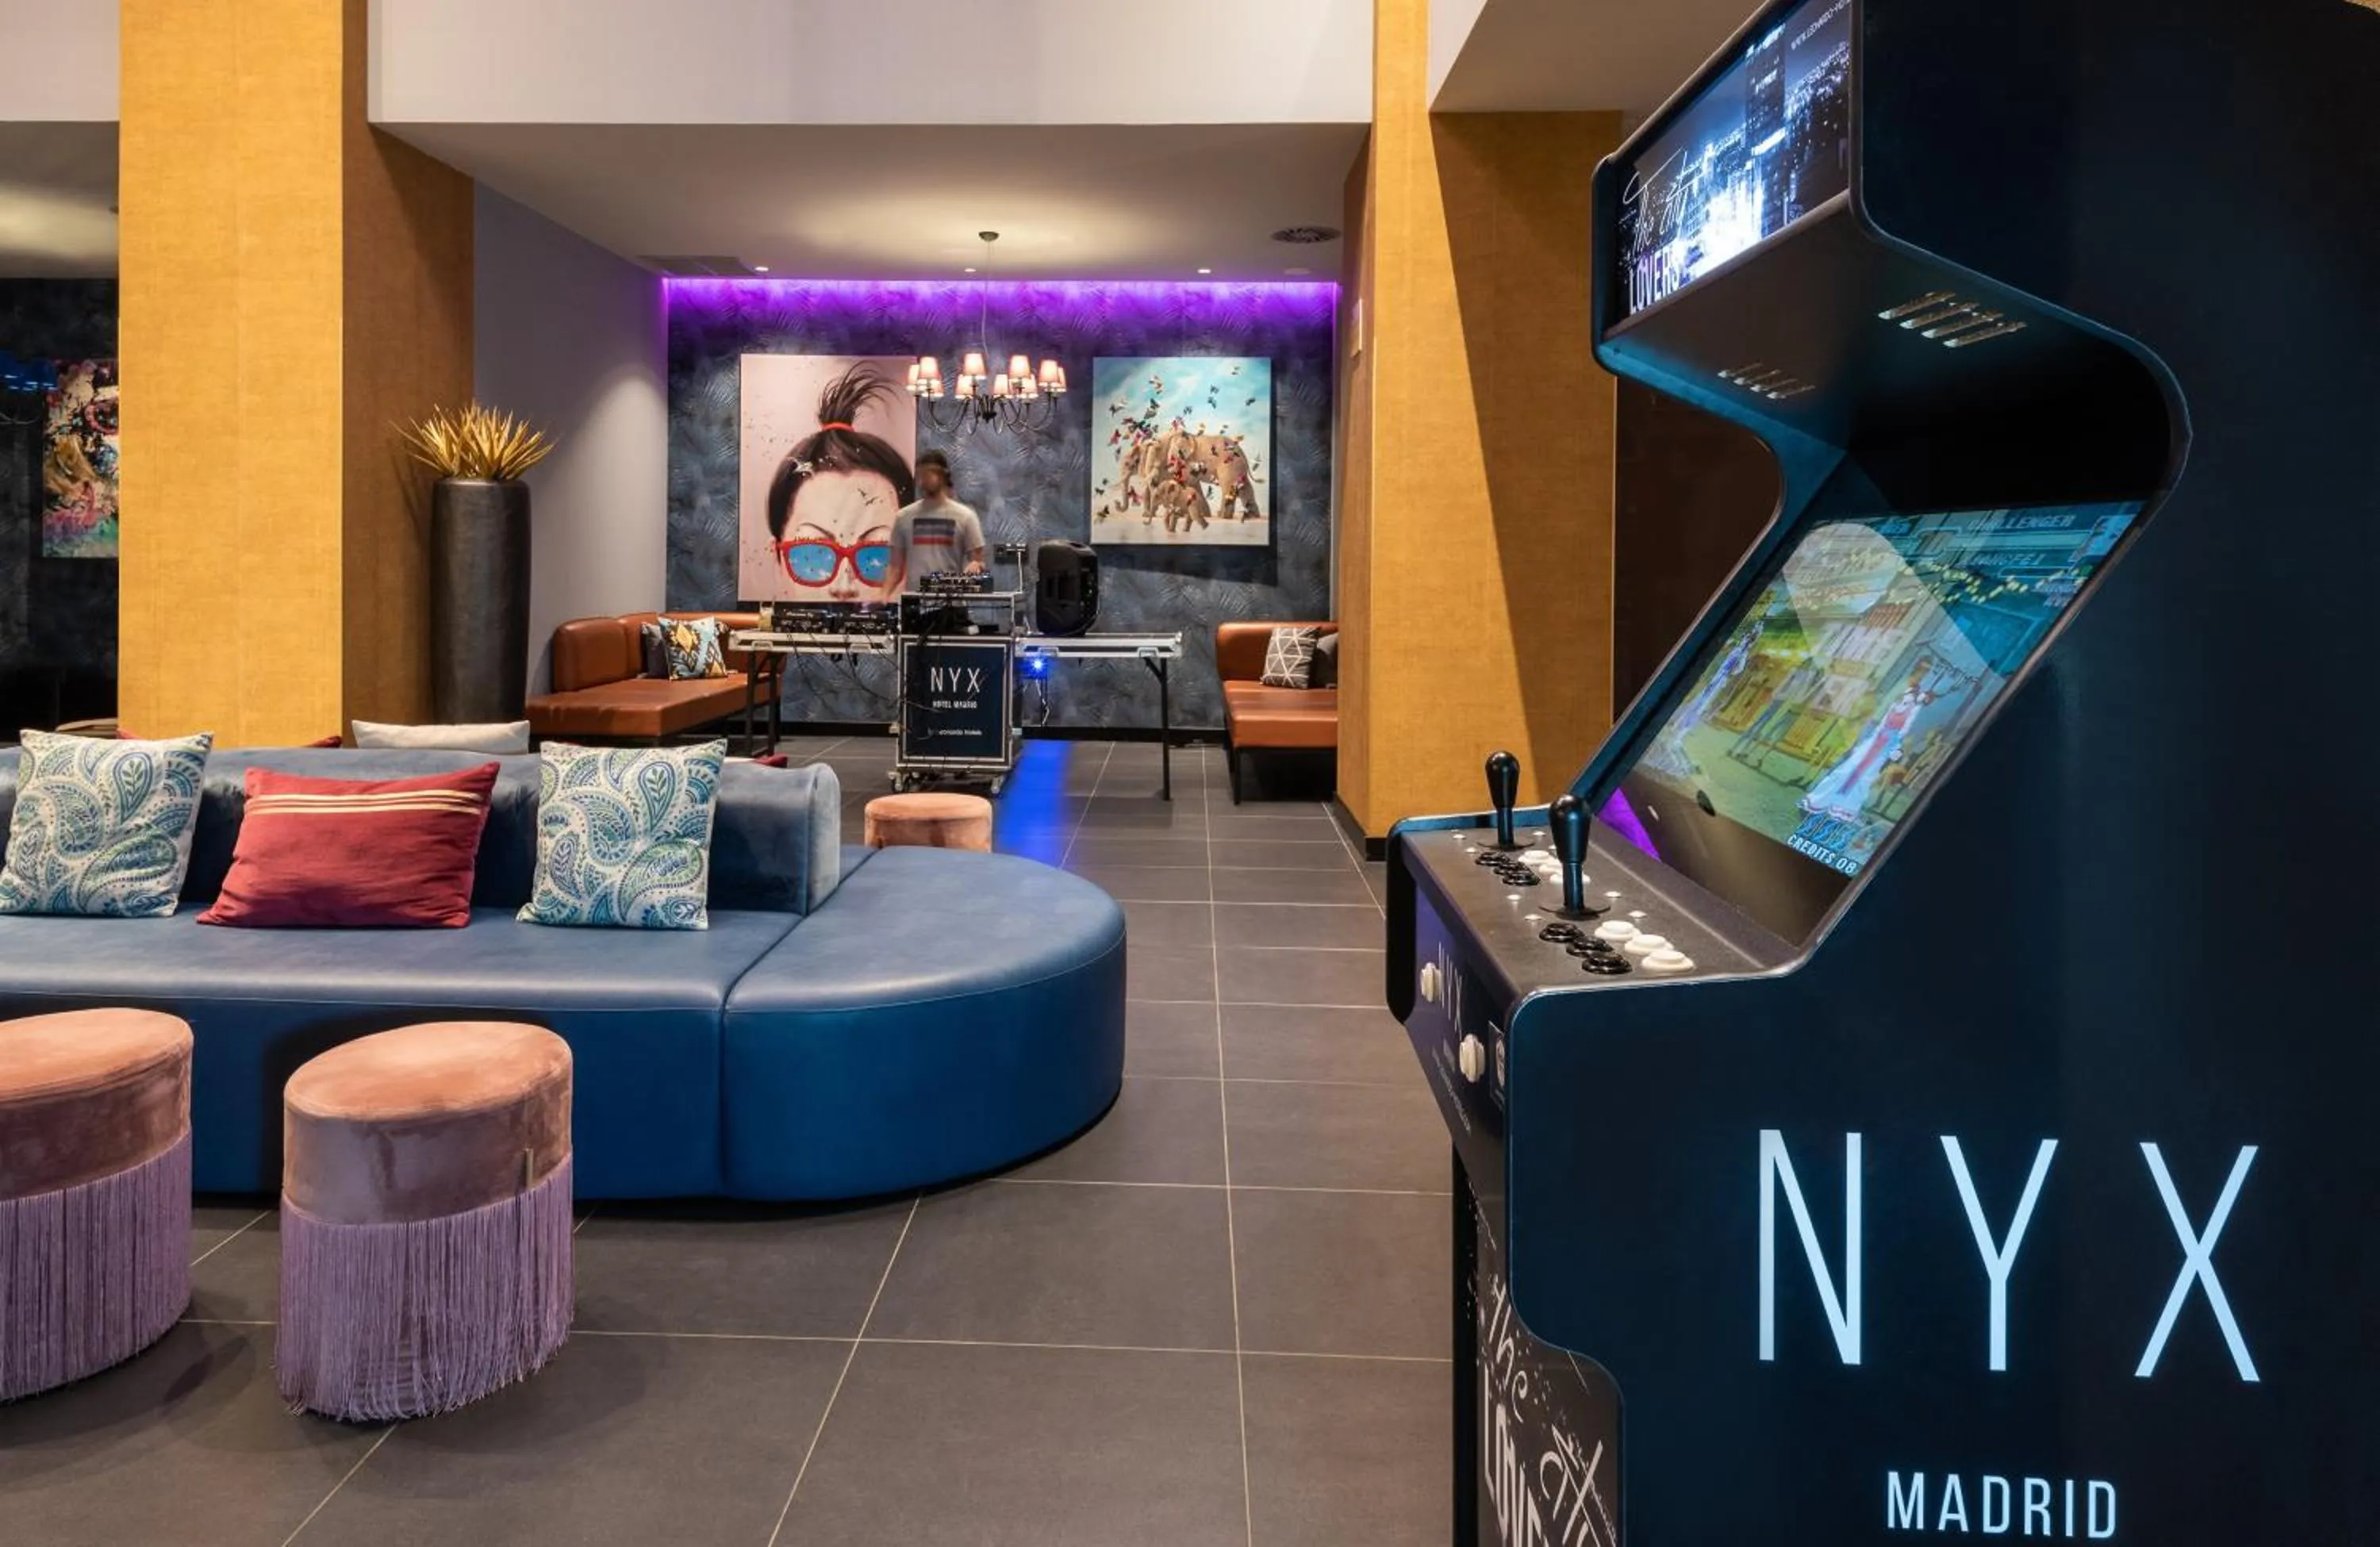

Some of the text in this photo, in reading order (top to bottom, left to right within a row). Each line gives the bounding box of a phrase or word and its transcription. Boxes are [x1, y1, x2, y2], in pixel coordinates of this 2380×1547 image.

[931, 666, 980, 693] NYX
[1787, 834, 1836, 864] CREDITS
[1759, 1128, 2261, 1382] NYX
[1887, 1470, 2117, 1538] MADRID
